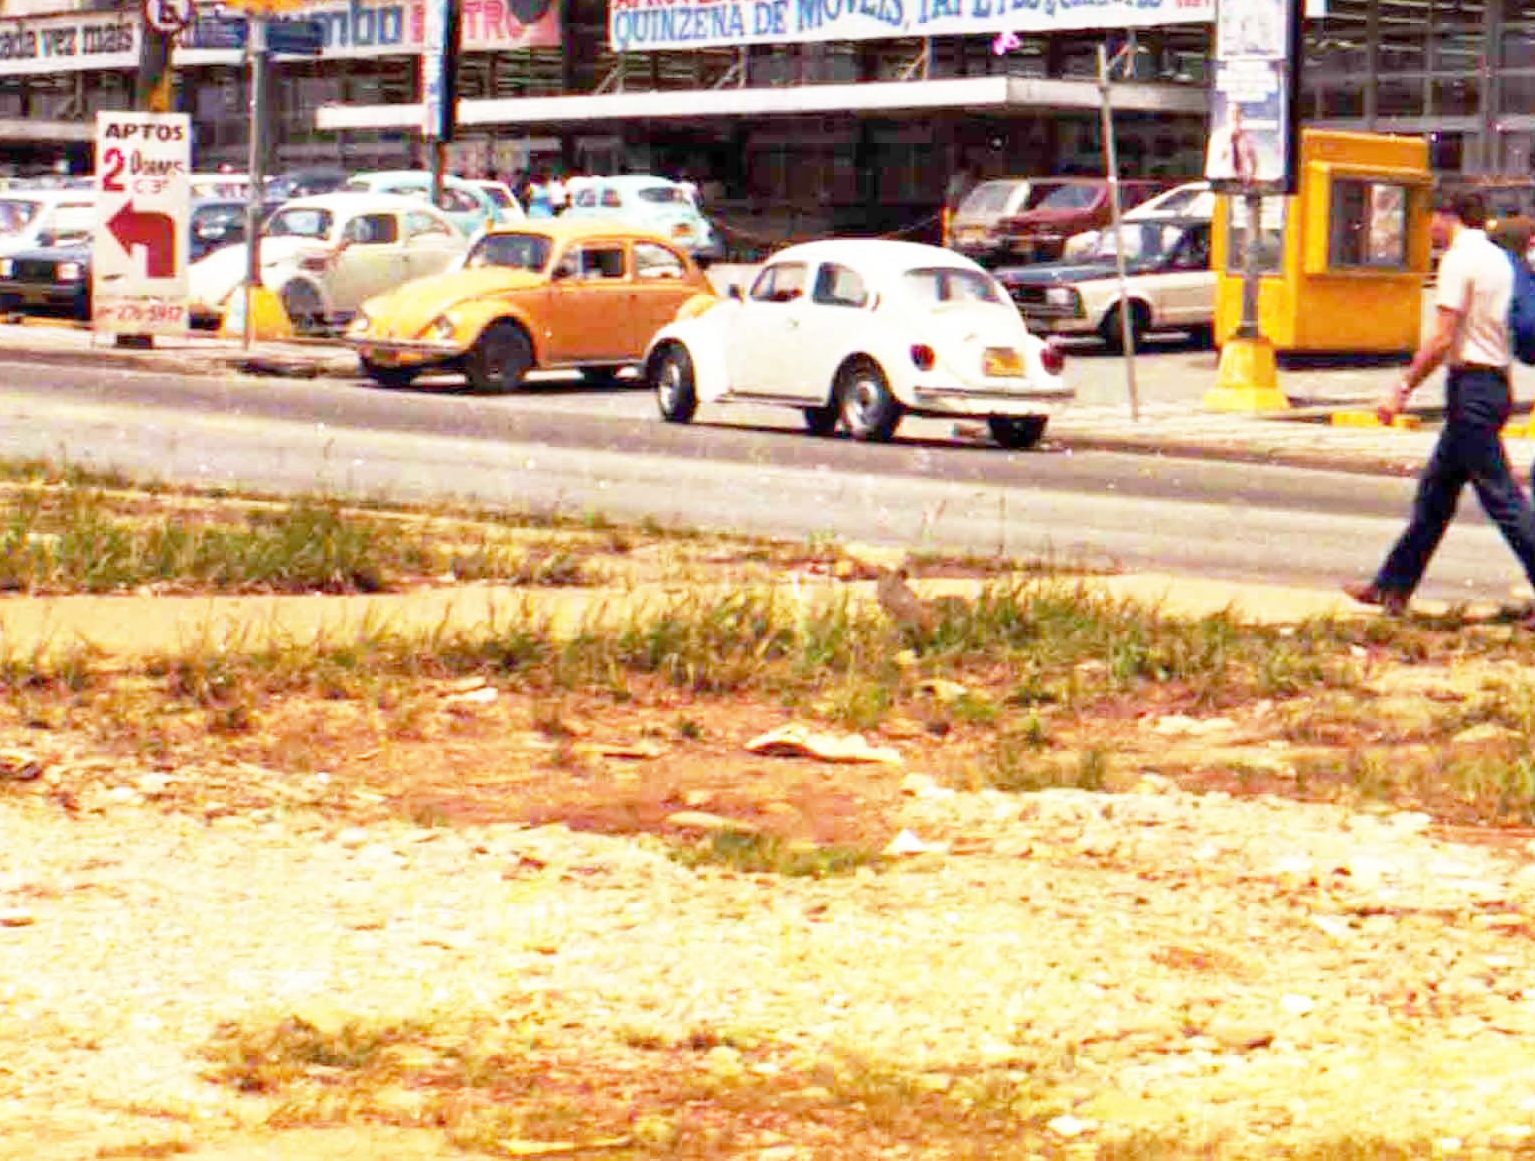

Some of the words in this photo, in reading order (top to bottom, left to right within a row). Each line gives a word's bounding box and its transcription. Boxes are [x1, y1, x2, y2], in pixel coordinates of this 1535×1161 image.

[39, 26, 78, 56] vez
[615, 4, 745, 50] QUINZENA
[105, 122, 184, 142] APTOS
[103, 147, 125, 192] 2
